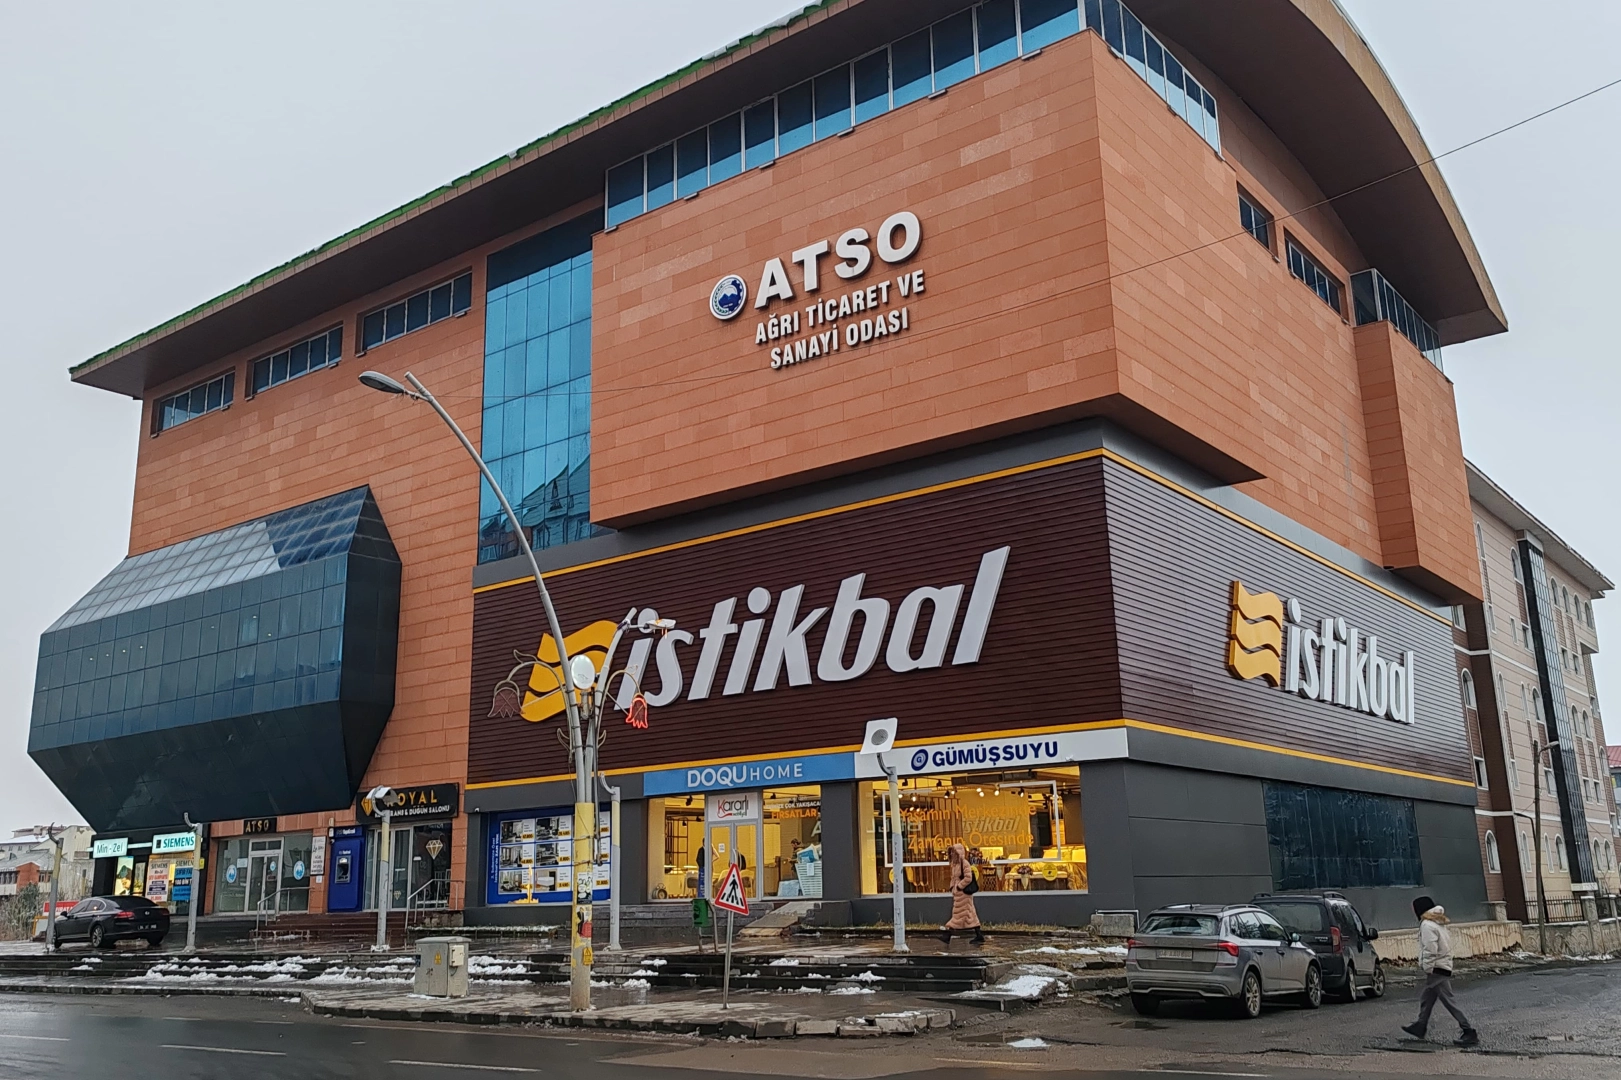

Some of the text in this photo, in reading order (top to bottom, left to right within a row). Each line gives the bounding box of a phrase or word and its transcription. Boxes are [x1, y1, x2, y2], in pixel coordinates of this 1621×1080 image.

[754, 211, 922, 310] ATSO
[755, 269, 925, 345] AĞRI TİCARET VE
[770, 307, 909, 369] SANAYİ ODASI
[613, 545, 1011, 711] istikbal
[1285, 597, 1415, 725] istikbal
[931, 741, 1059, 767] GÜMÜŞSUYU
[687, 763, 803, 788] DOQU HOME
[386, 789, 438, 807] OYAL
[428, 804, 450, 814] SALONU
[771, 808, 817, 820] FIRSATLAR
[900, 808, 951, 825] Yaşamın
[955, 803, 1036, 820] Merkezinde
[245, 820, 269, 833] ATSO
[97, 844, 108, 854] Min
[113, 843, 123, 853] Zel
[163, 836, 194, 848] SIEMENS
